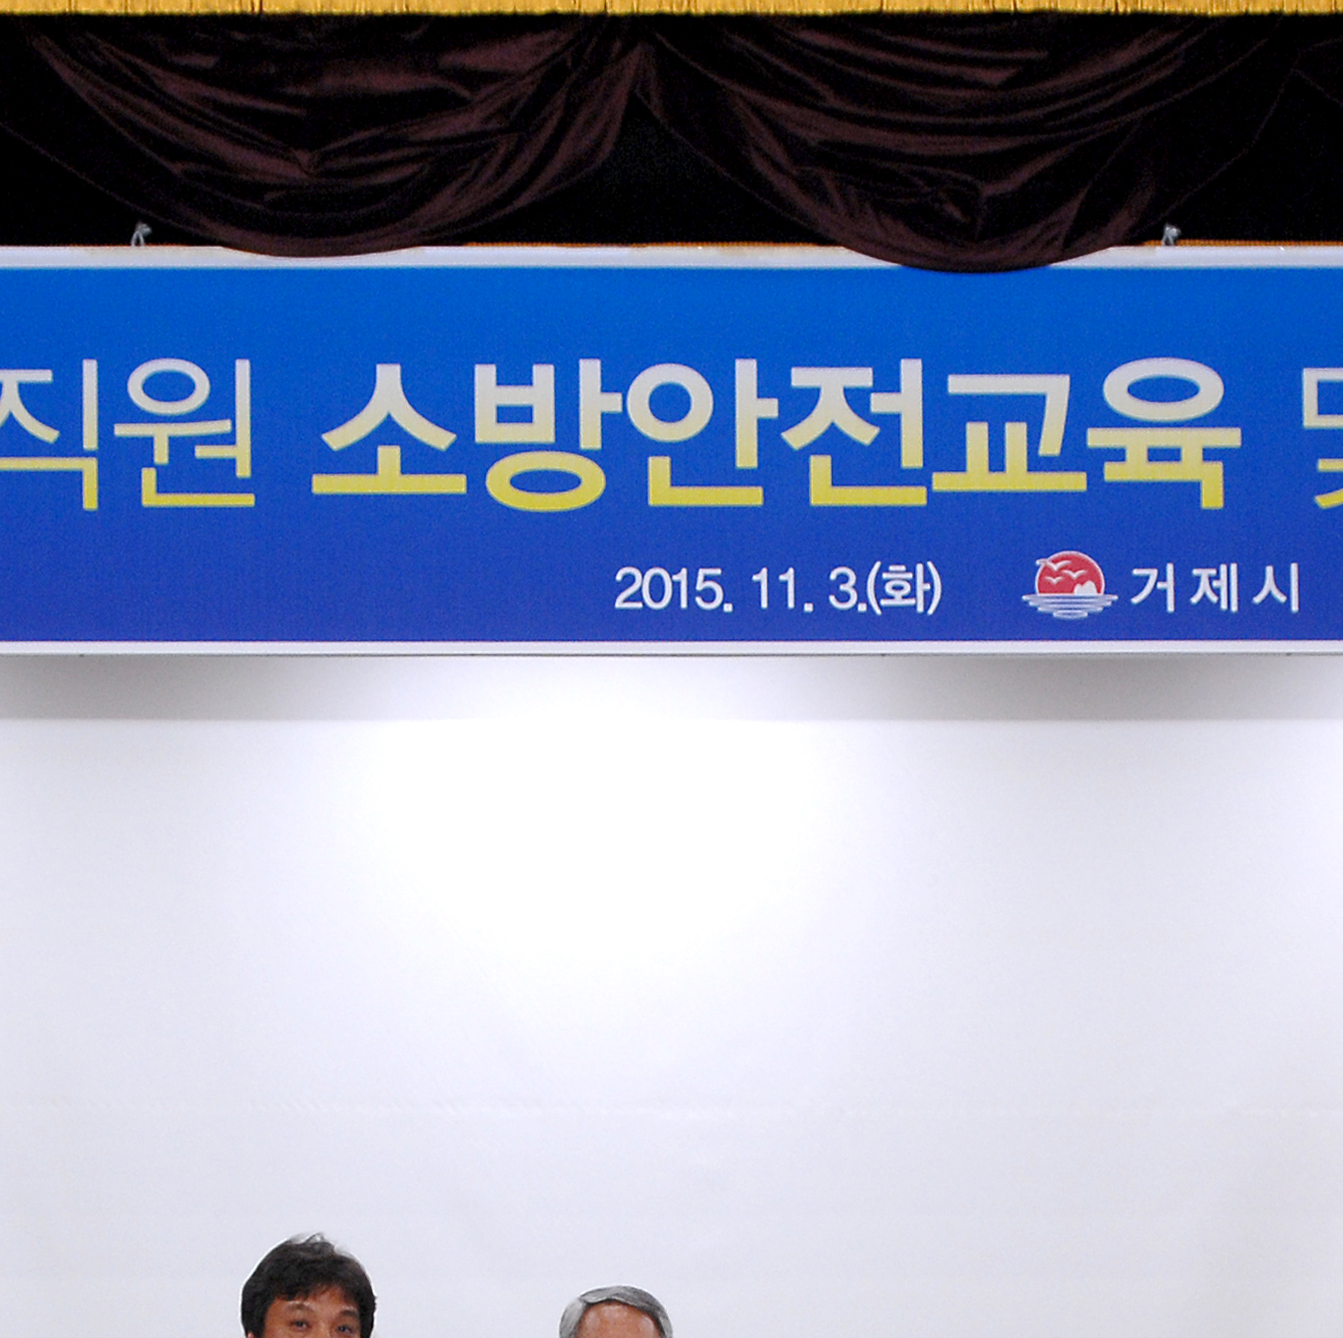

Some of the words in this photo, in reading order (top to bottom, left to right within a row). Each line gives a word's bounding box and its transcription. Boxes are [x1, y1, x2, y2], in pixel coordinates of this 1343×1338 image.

[311, 357, 1242, 512] 소방안전교육
[613, 565, 734, 614] 2015.
[750, 566, 815, 614] 11.
[828, 560, 943, 616] 3.(화)
